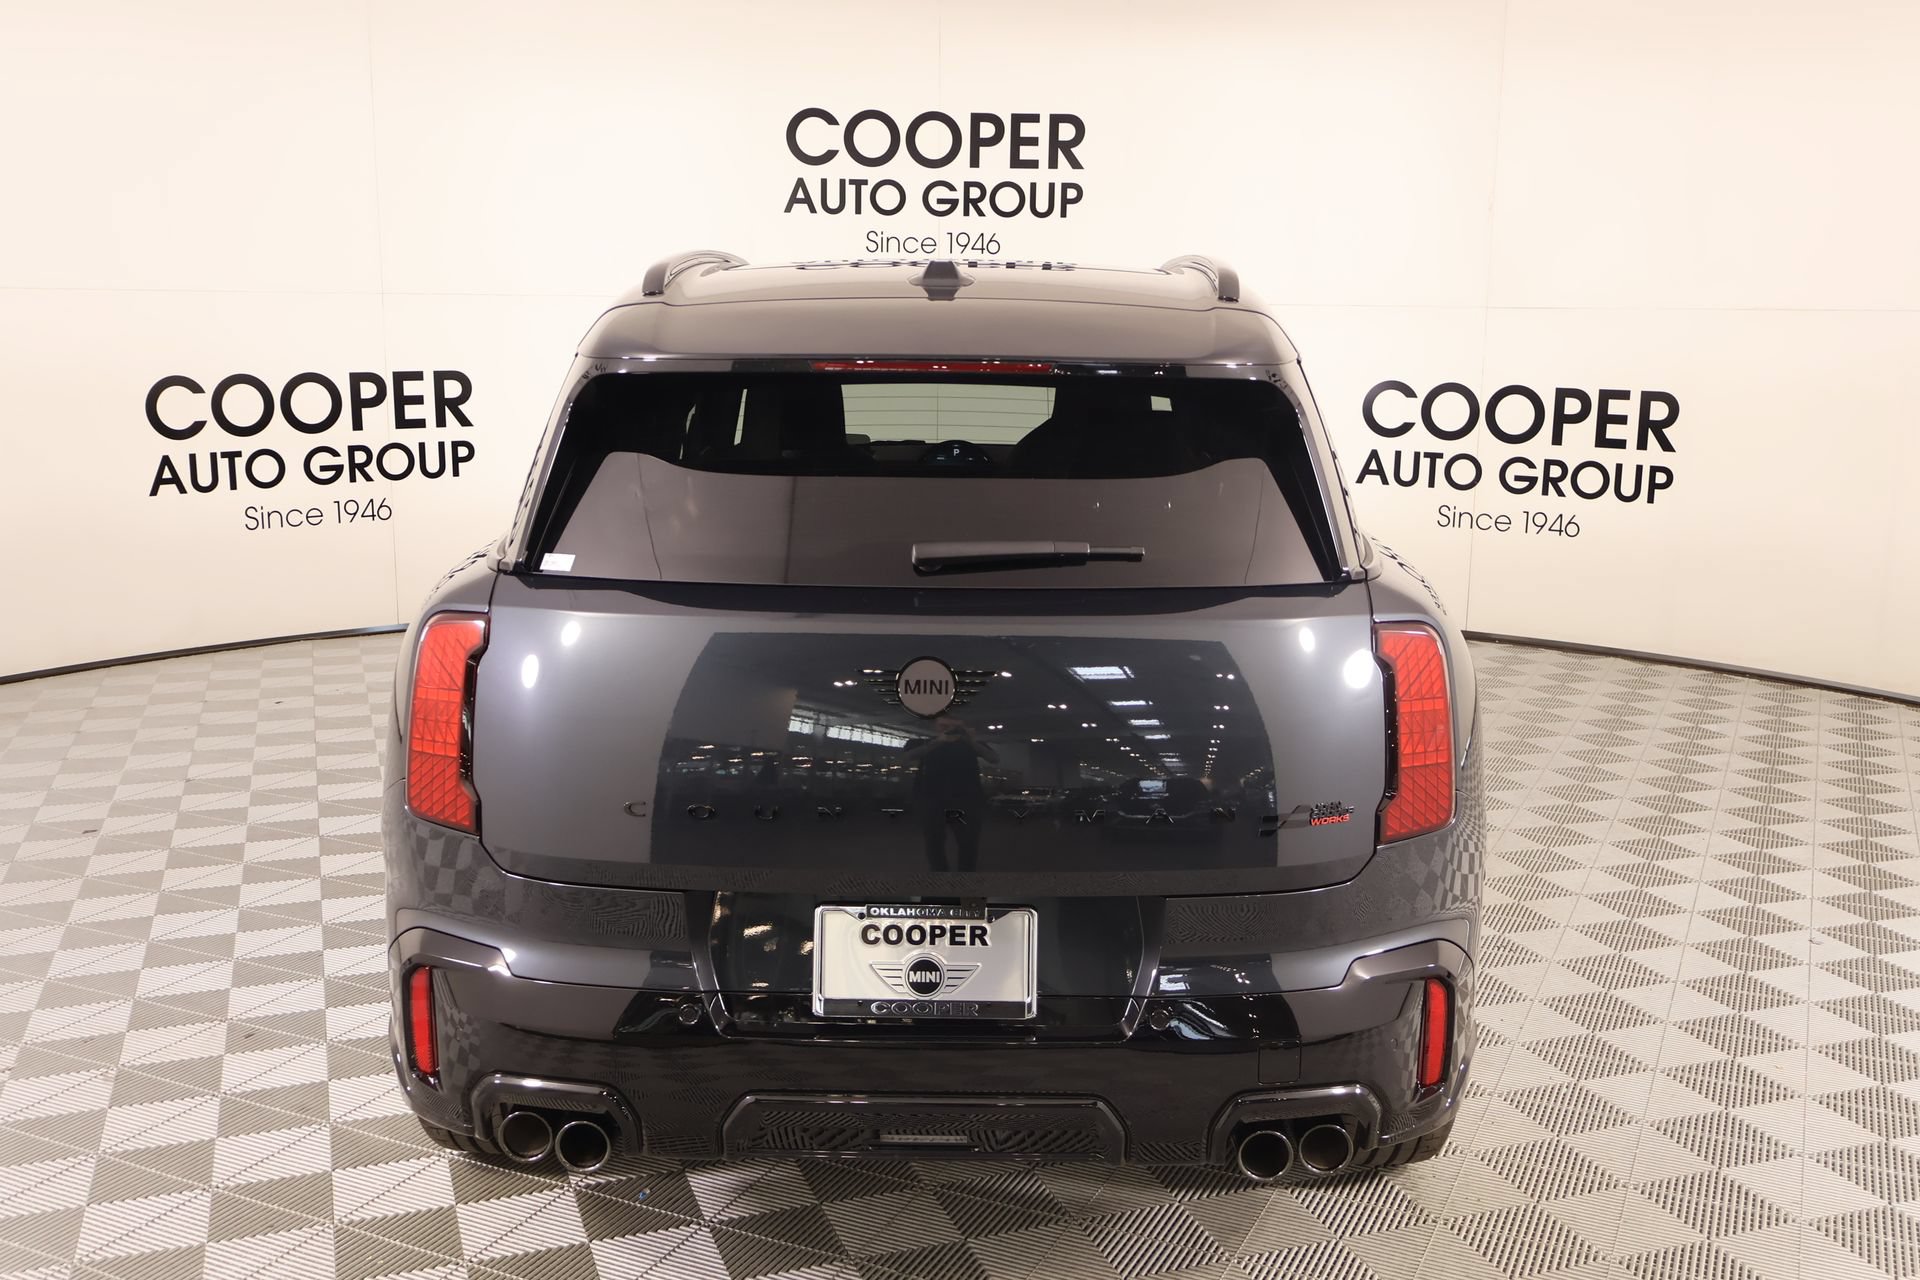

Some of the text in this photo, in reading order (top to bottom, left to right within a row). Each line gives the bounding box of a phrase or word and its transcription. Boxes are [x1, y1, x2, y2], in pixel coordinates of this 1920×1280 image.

[785, 107, 1086, 170] COOPER
[784, 177, 1084, 219] AUTO GROUP
[865, 230, 1001, 256] Since 1946
[144, 369, 475, 441] COOPER
[1361, 379, 1681, 453] COOPER
[953, 448, 960, 456] P
[148, 439, 476, 497] AUTO GROUP
[1354, 448, 1675, 505] AUTO GROUP
[244, 497, 393, 531] Since 1946
[1436, 504, 1581, 538] Since 1946
[904, 679, 949, 696] MINI
[623, 799, 1237, 824] COUNTRYMAN
[1310, 814, 1351, 827] WORKS
[869, 906, 946, 917] OKLAHOMA
[861, 923, 990, 947] COOPER
[908, 970, 941, 984] MINI
[870, 1001, 979, 1016] COOPER
